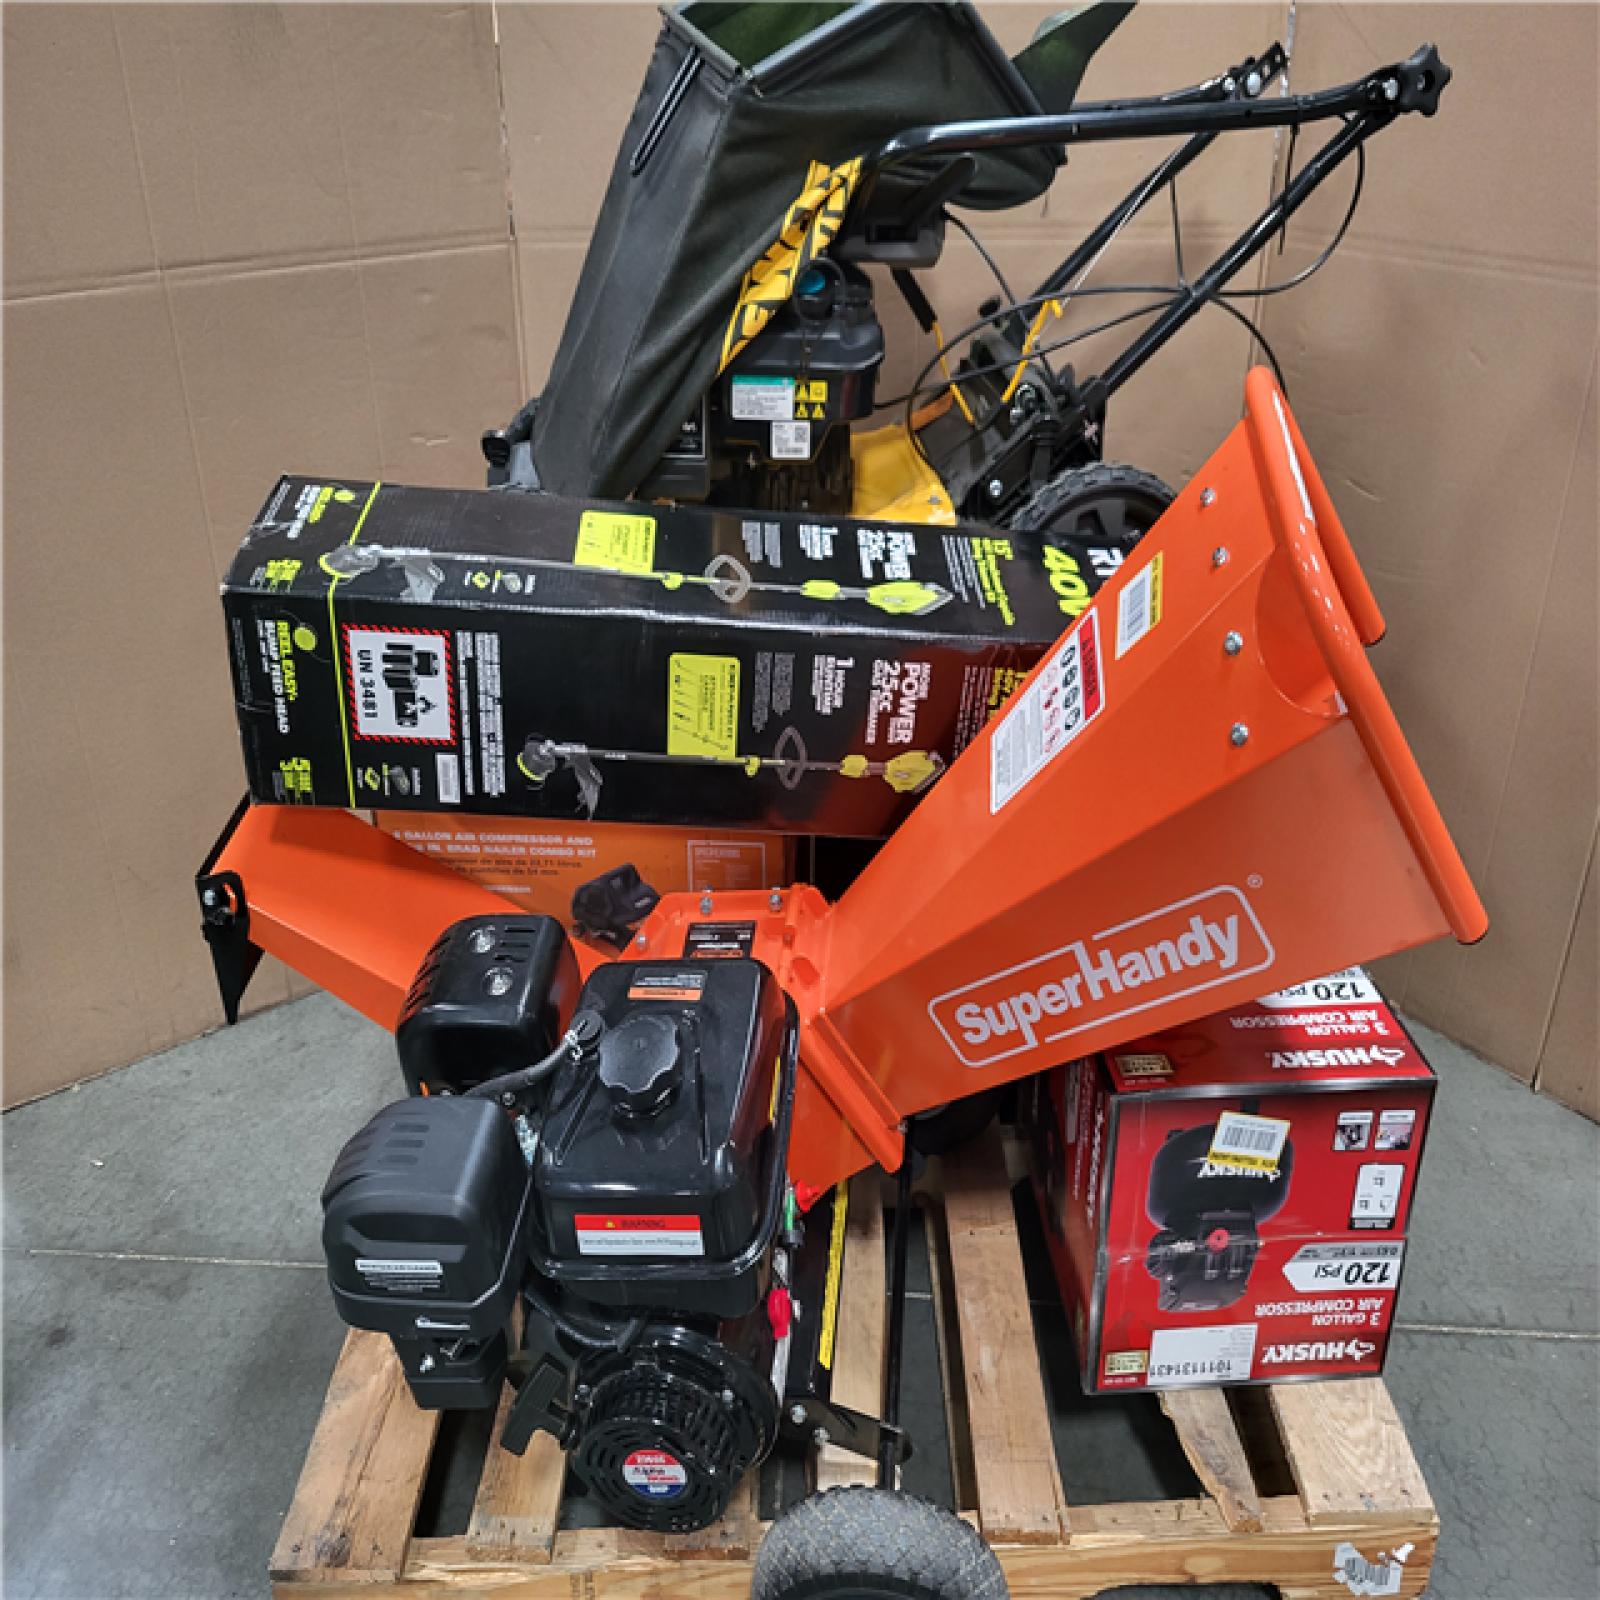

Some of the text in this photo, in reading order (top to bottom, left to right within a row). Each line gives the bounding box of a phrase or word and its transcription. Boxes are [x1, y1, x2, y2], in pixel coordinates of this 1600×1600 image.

[276, 620, 293, 656] REEL
[264, 620, 290, 734] BUMP FEED HEAD
[356, 649, 378, 718] UN 3481
[821, 656, 836, 714] RUNTIME
[833, 657, 854, 708] 1 HOUR
[879, 660, 900, 712] 25cc
[919, 662, 931, 699] MORE
[865, 659, 883, 744] GAS TRIMMER
[898, 661, 921, 743] POWER
[404, 831, 451, 841] GALLON
[455, 832, 476, 841] AIR
[480, 833, 563, 845] COMPRESSOR
[567, 836, 593, 846] AND
[447, 844, 481, 853] BRAD
[483, 846, 526, 856] NAILER
[529, 847, 574, 857] COMBO
[955, 915, 1239, 1047] SuperHandy
[1313, 981, 1367, 1001] 120
[1230, 1009, 1379, 1030] AIR COMPRESSOR
[1304, 1021, 1390, 1037] 3 GALLON
[1270, 1046, 1374, 1069] HUSKY
[1314, 1262, 1391, 1285] 120 PSI
[1254, 1297, 1386, 1318] AIR COMPRESSOR
[1312, 1313, 1382, 1327] 3 GALLON
[1262, 1338, 1346, 1366] HUSKY
